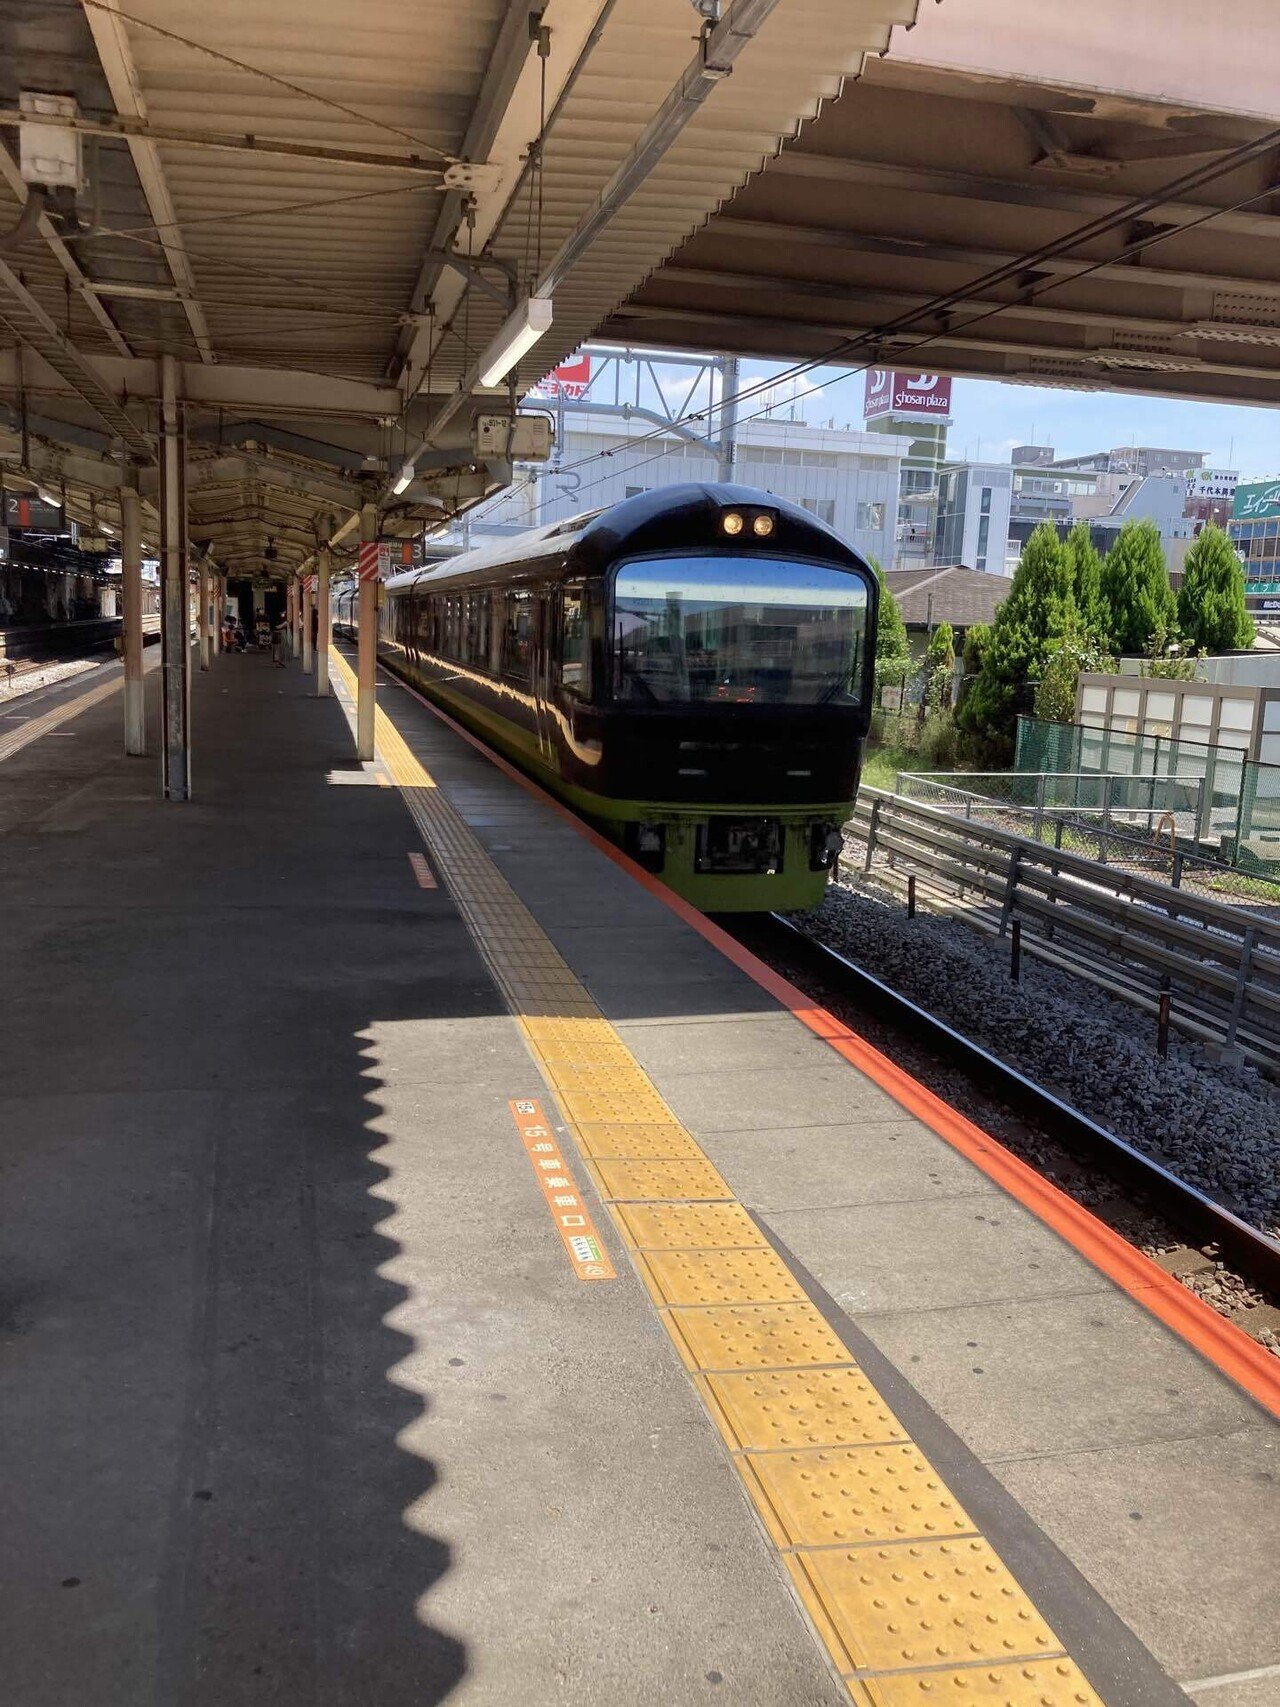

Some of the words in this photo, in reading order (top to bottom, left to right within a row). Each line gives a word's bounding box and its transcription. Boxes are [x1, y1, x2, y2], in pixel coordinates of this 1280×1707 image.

[895, 391, 925, 407] Shosan
[926, 394, 948, 408] plaza
[9, 499, 18, 513] 2
[412, 543, 422, 559] 3
